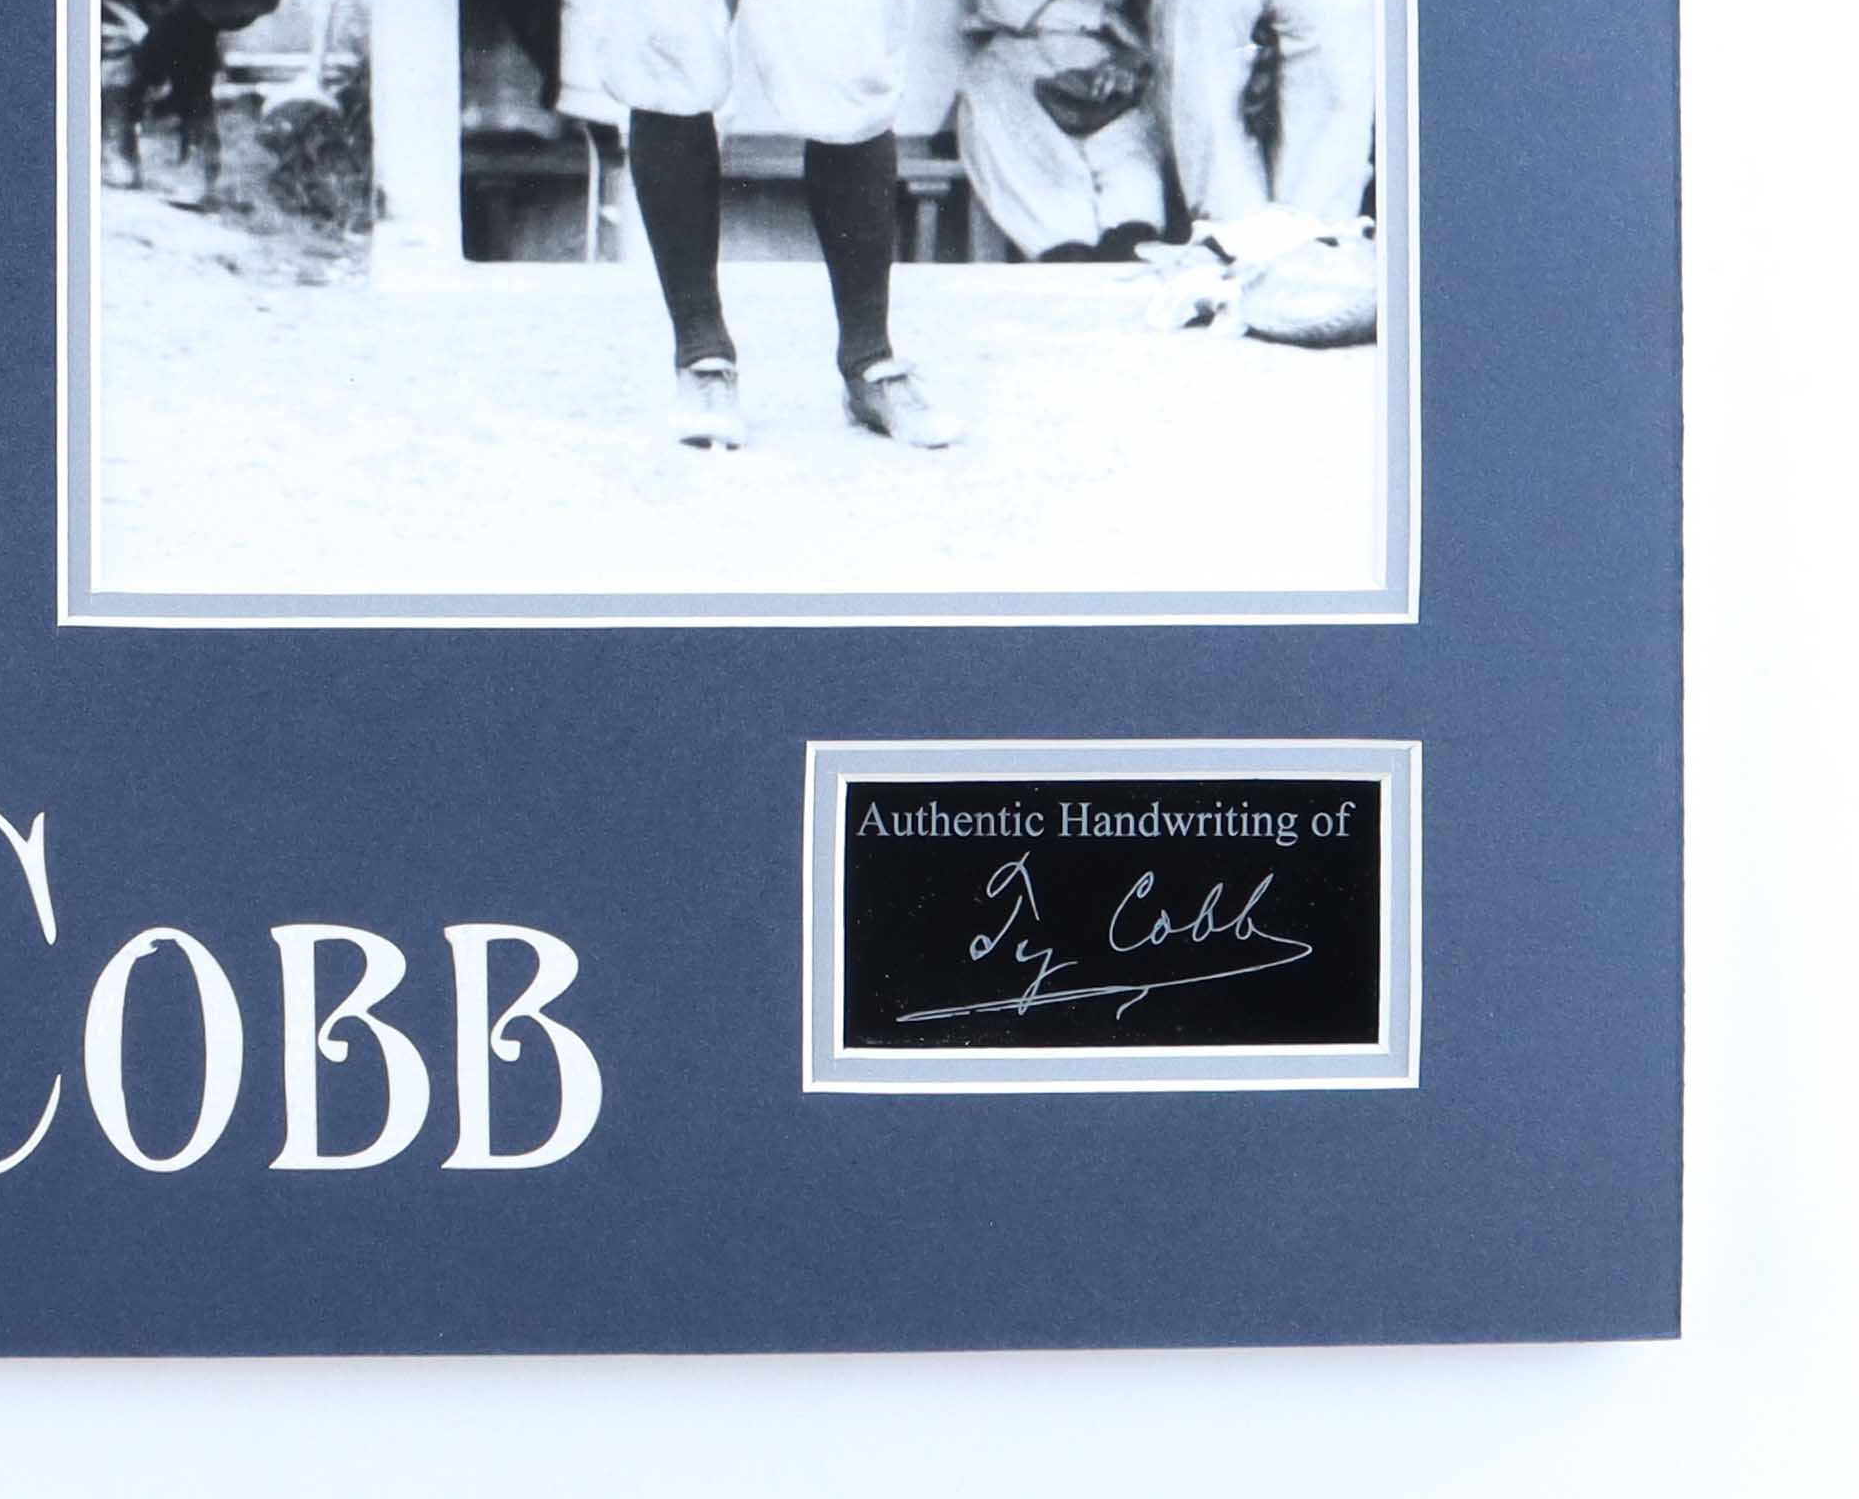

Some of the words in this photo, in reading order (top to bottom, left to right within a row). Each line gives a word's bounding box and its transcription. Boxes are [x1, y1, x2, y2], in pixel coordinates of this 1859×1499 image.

[856, 800, 1046, 838] Authentic
[1058, 800, 1300, 848] Handwriting
[1311, 800, 1357, 838] of
[969, 851, 1079, 1015] Ty
[1108, 871, 1300, 953] Cobb
